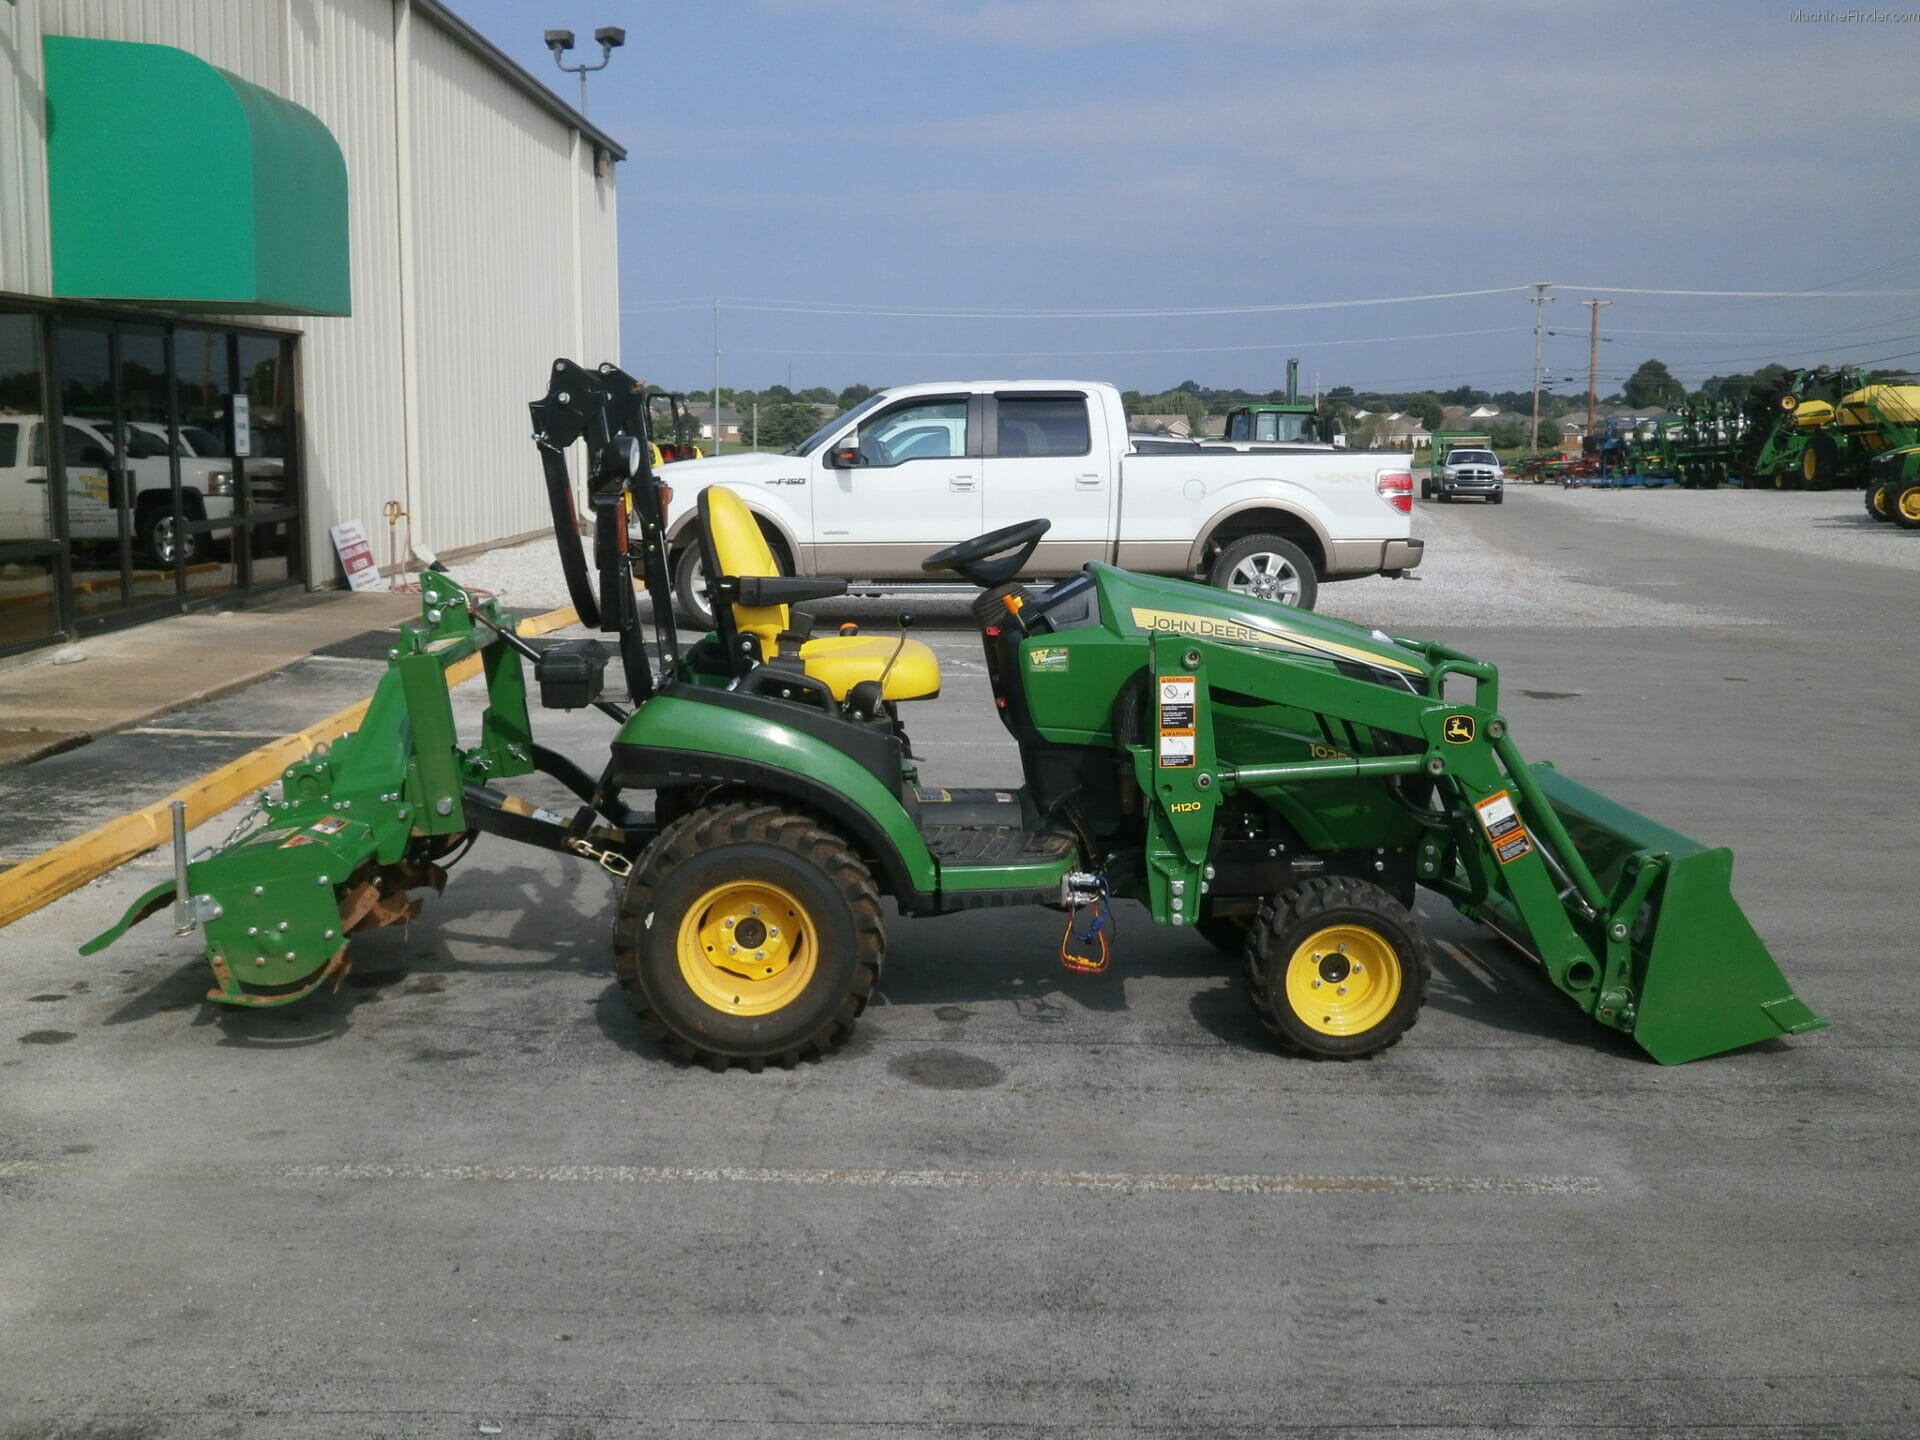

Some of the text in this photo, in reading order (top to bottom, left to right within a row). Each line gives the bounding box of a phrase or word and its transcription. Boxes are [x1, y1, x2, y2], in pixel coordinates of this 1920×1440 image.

[1147, 615, 1259, 641] JOHN DEERE
[1171, 801, 1201, 813] H120
